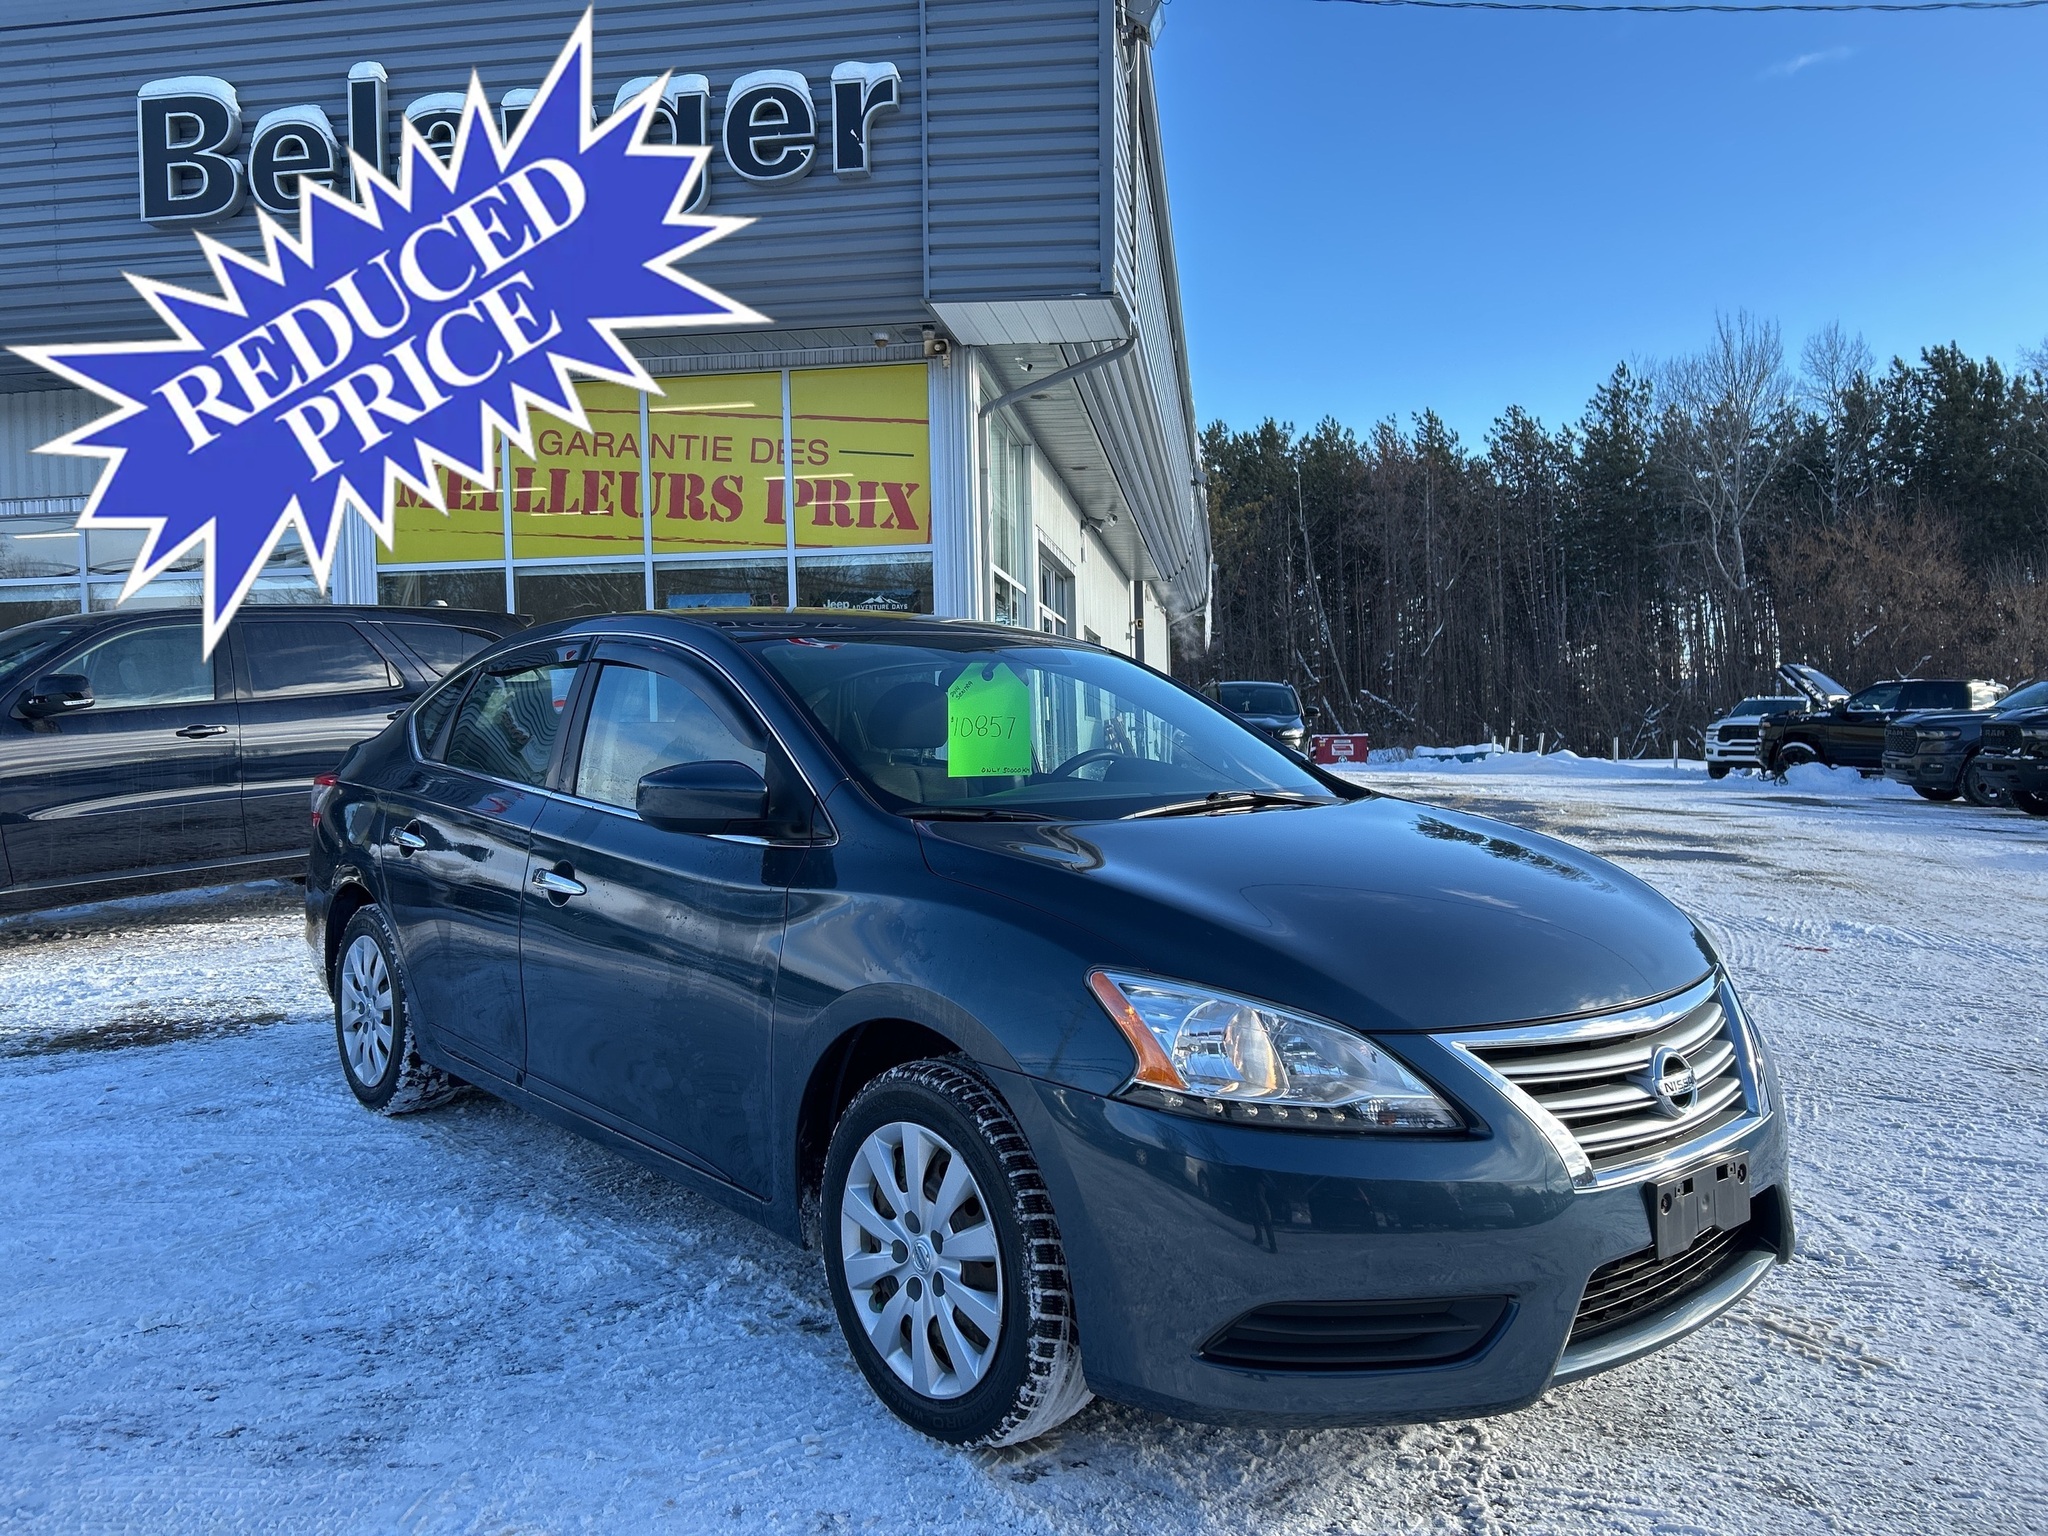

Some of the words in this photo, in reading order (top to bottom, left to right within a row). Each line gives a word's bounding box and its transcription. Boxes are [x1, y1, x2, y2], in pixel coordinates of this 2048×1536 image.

[138, 70, 900, 224] Beler
[538, 429, 733, 462] GARANTIE
[750, 437, 829, 466] DES
[763, 478, 920, 530] PRIX
[823, 599, 849, 609] Jeep
[1985, 729, 2005, 737] RAM
[1664, 1076, 1695, 1092] NISSA
